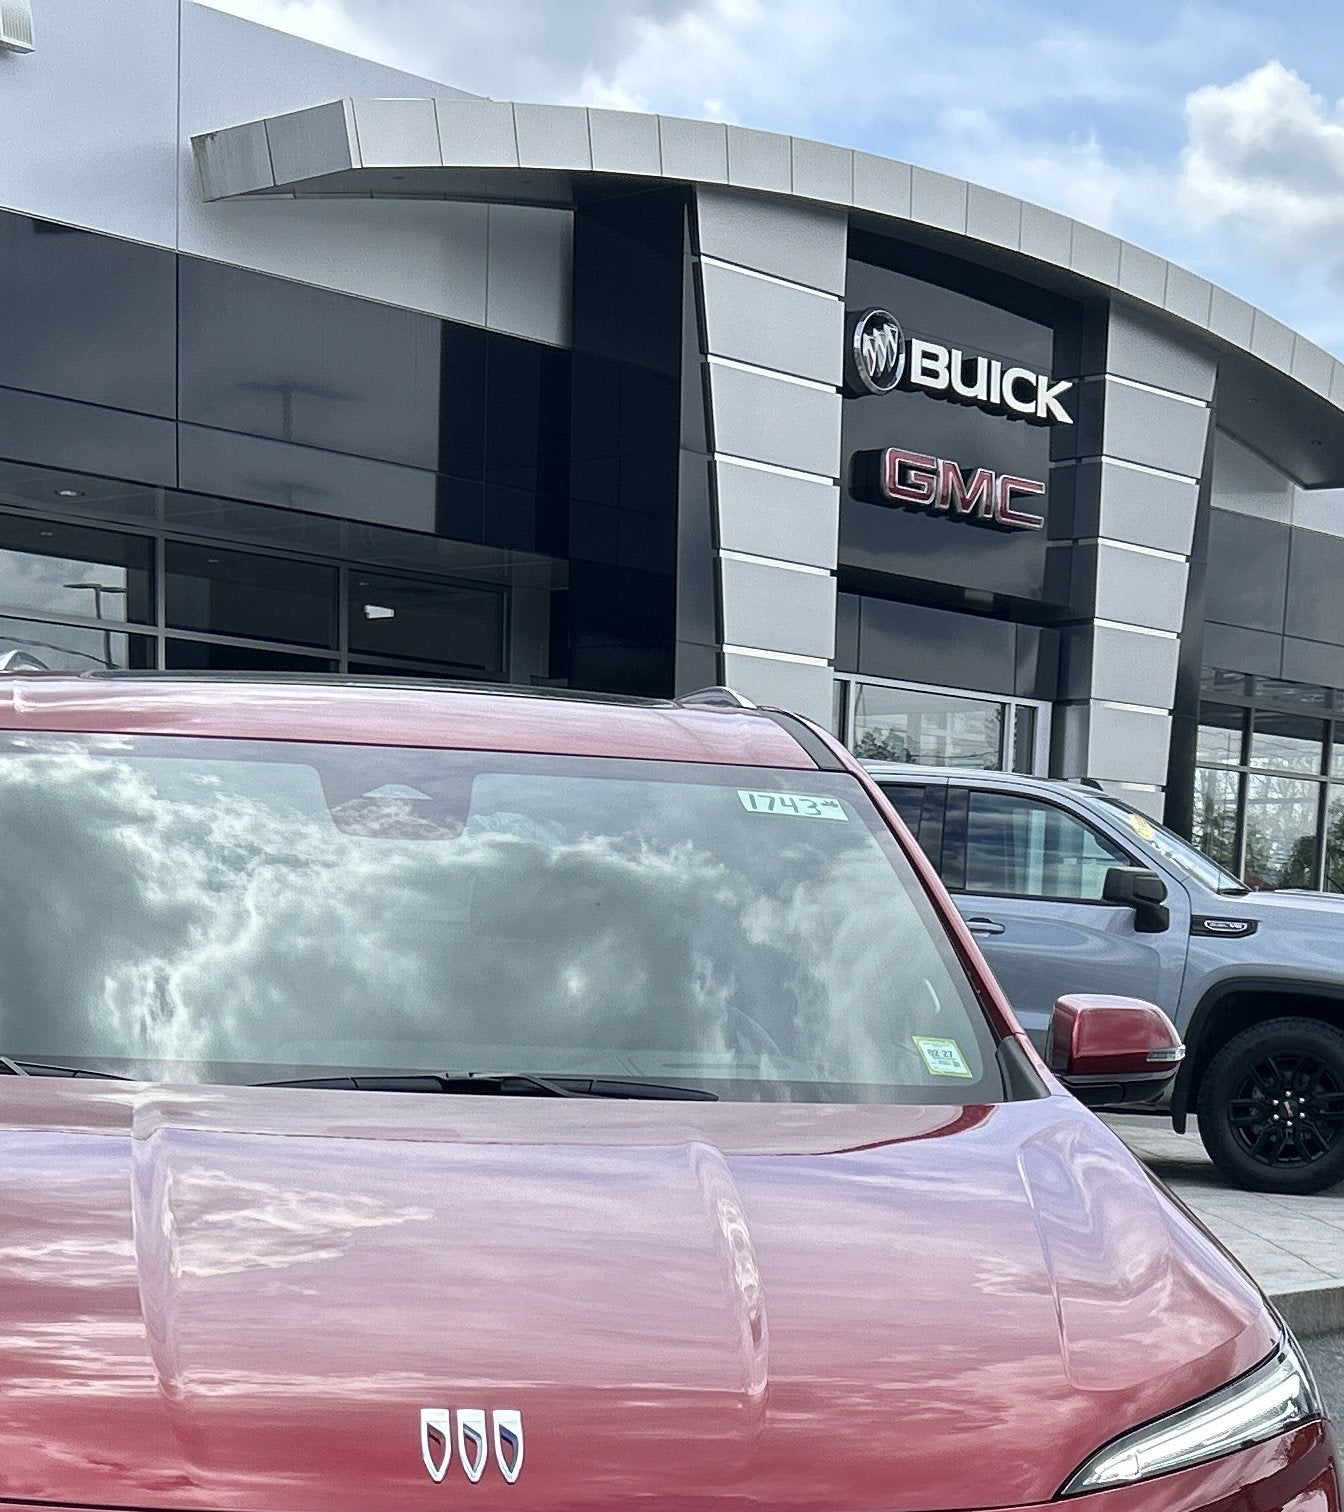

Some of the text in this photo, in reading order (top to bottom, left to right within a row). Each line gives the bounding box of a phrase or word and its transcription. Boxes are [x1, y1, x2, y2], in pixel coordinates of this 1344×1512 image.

[910, 337, 1074, 424] BUICK
[884, 446, 1046, 529] GMC
[748, 792, 823, 816] 1743
